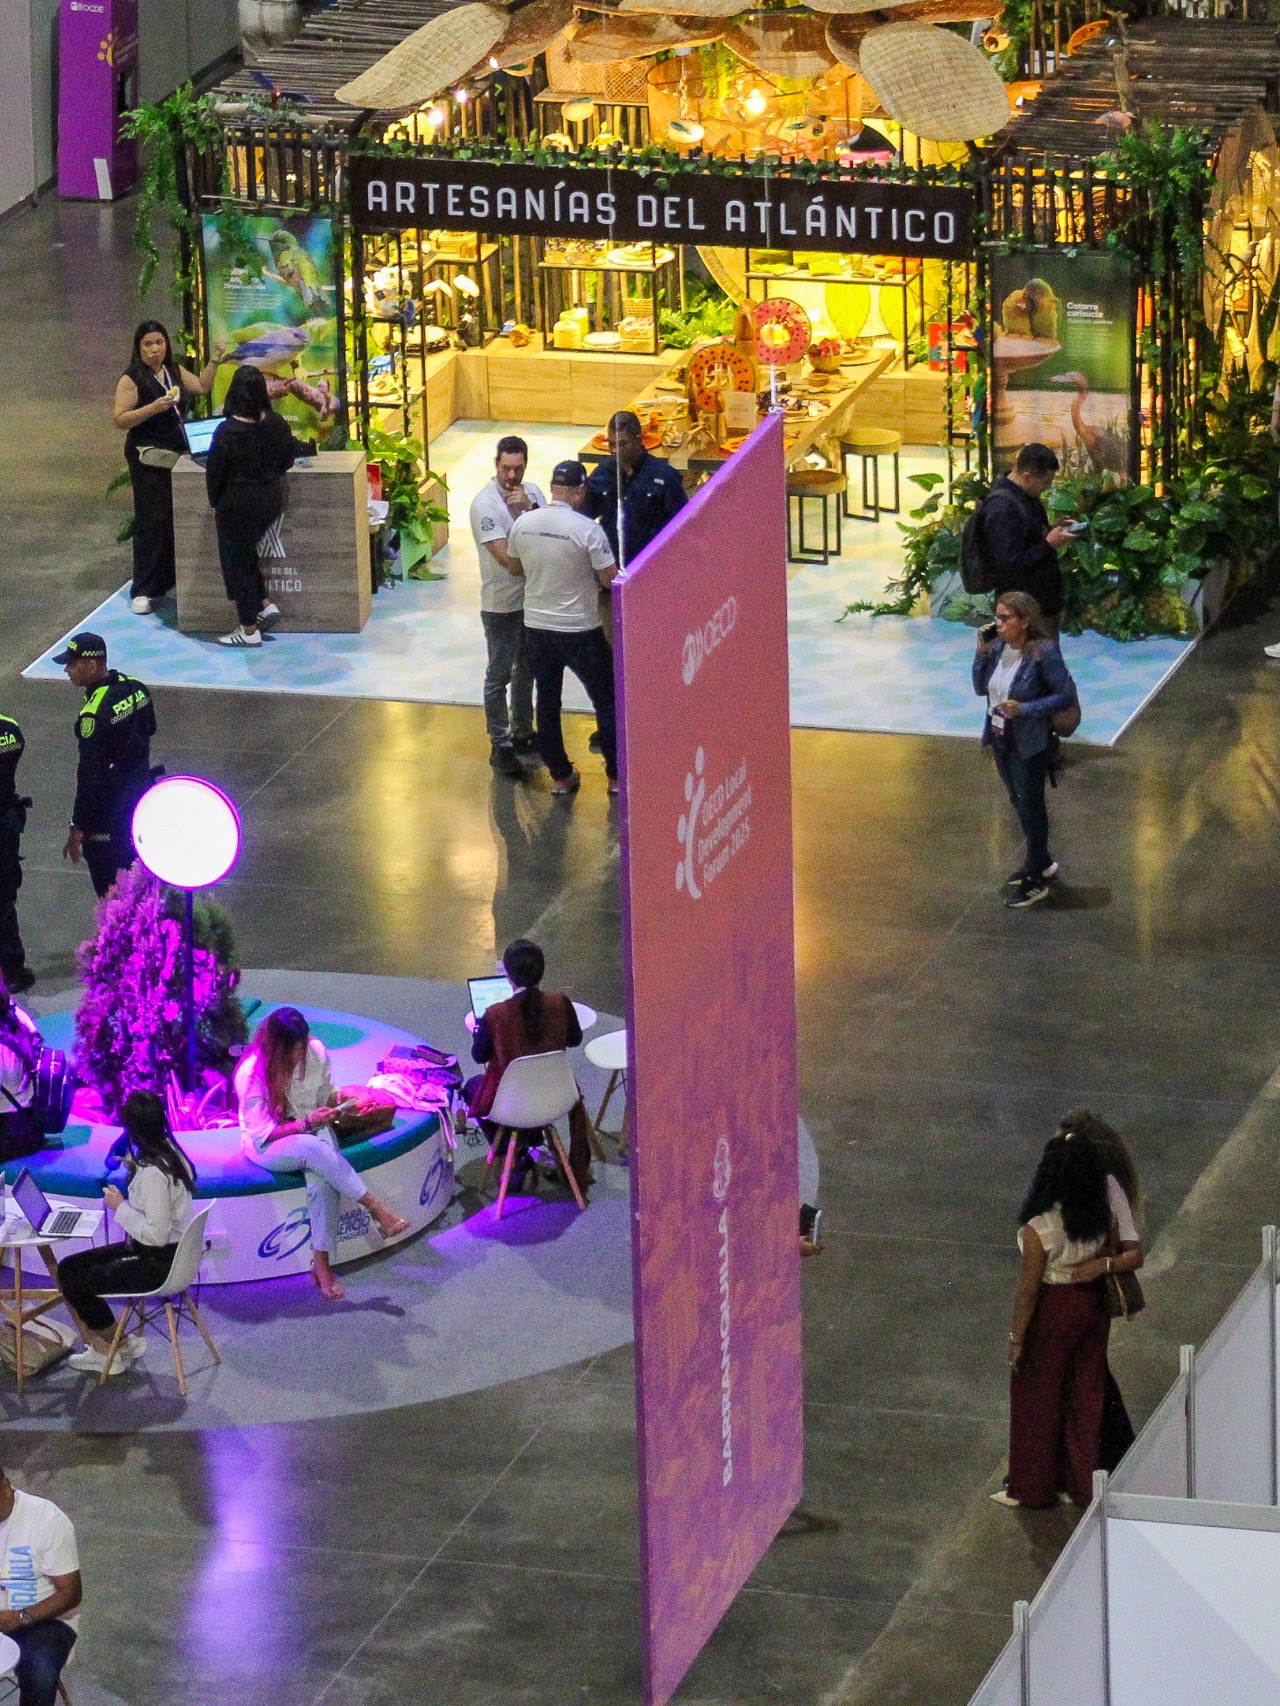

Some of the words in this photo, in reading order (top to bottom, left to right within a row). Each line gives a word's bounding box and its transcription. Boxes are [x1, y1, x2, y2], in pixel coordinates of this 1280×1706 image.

[366, 180, 617, 225] ARTESANÍAS
[637, 195, 706, 231] DEL
[724, 195, 956, 244] ATLÁNTICO
[283, 567, 298, 576] DEL
[698, 784, 752, 863] Development
[718, 1206, 733, 1488] BARRANQUILLA
